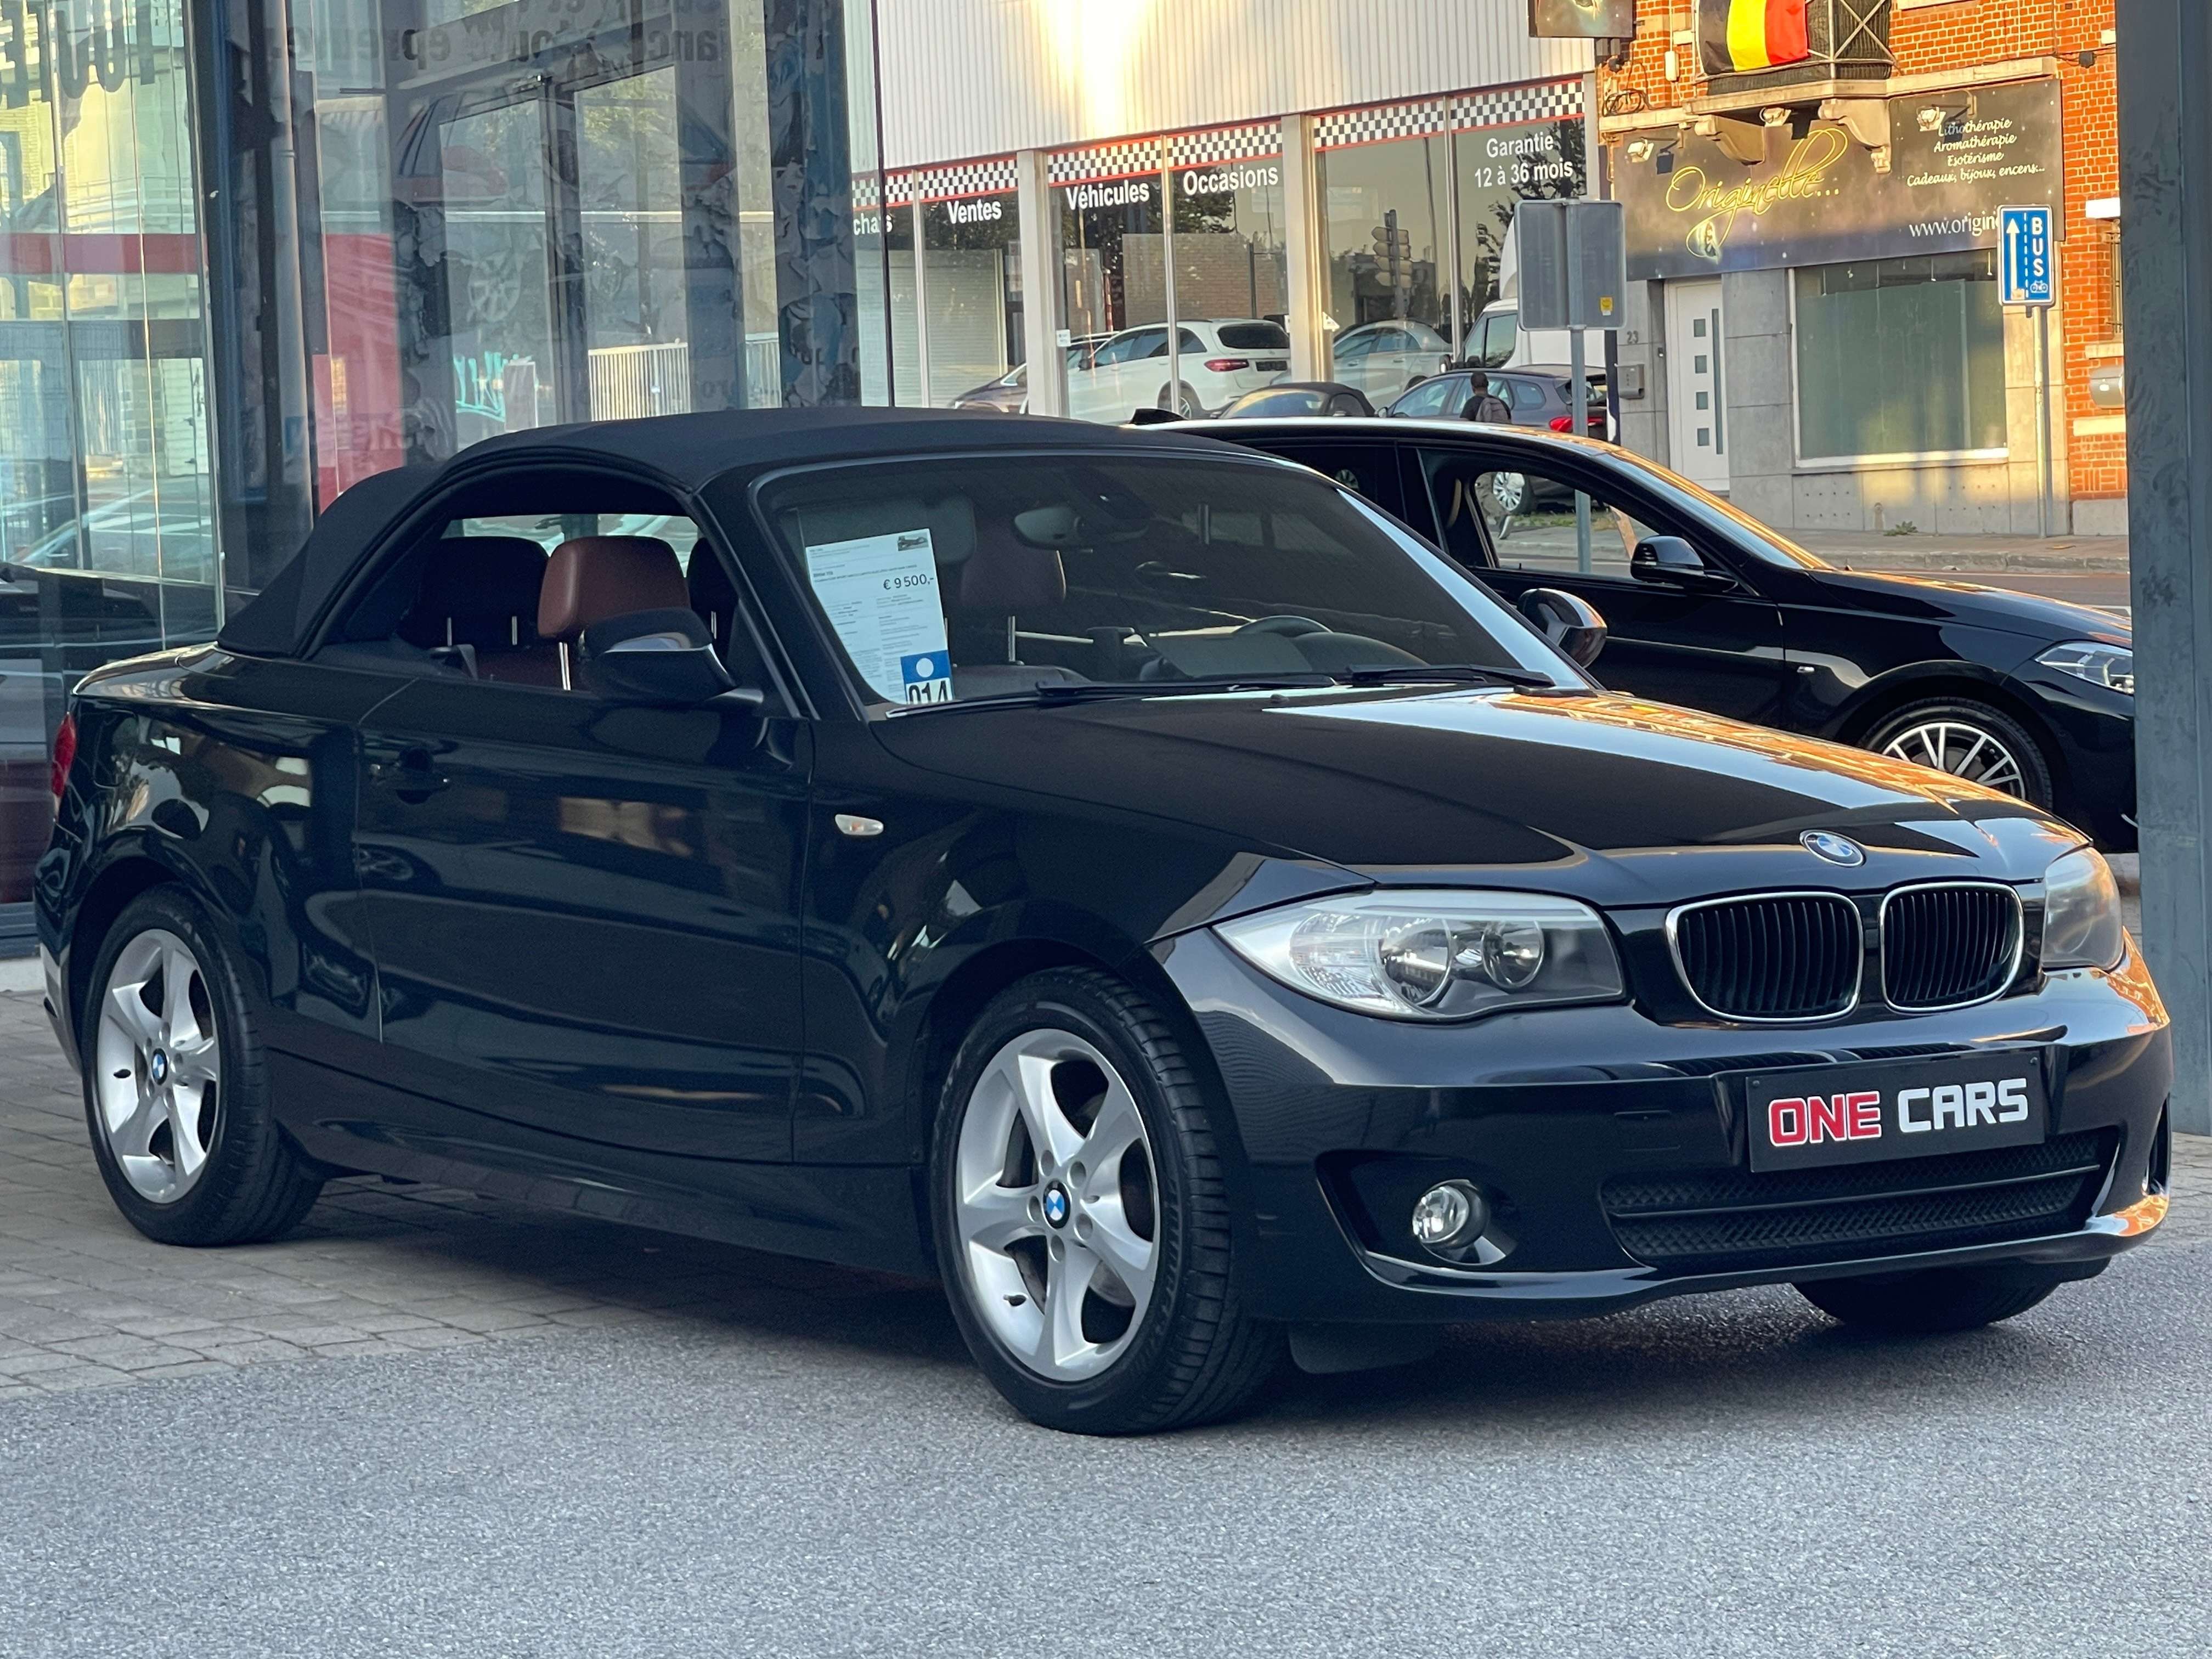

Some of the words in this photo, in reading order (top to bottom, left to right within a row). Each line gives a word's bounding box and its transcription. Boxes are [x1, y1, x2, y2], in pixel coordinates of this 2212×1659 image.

[1938, 117, 2012, 137] Lithothérapie
[1486, 131, 1554, 158] Garantie
[1933, 133, 2017, 153] Aromathérapie
[1948, 151, 2005, 167] Esotérisme
[1475, 167, 1492, 188] 12
[1497, 166, 1506, 185] à
[1511, 162, 1530, 183] 36
[1533, 157, 1573, 181] mois
[1907, 172, 1957, 187] Cadeaux,
[1960, 168, 1996, 184] bijoux,
[947, 198, 1002, 224] Ventes
[1065, 179, 1150, 211] Véhicules
[1183, 165, 1279, 196] Occasions
[2032, 217, 2045, 277] BUS
[1627, 330, 1639, 344] 23
[883, 579, 891, 590] €
[909, 680, 949, 702] 014
[1768, 1091, 1882, 1147] ONE
[1898, 1078, 2029, 1133] CARS
